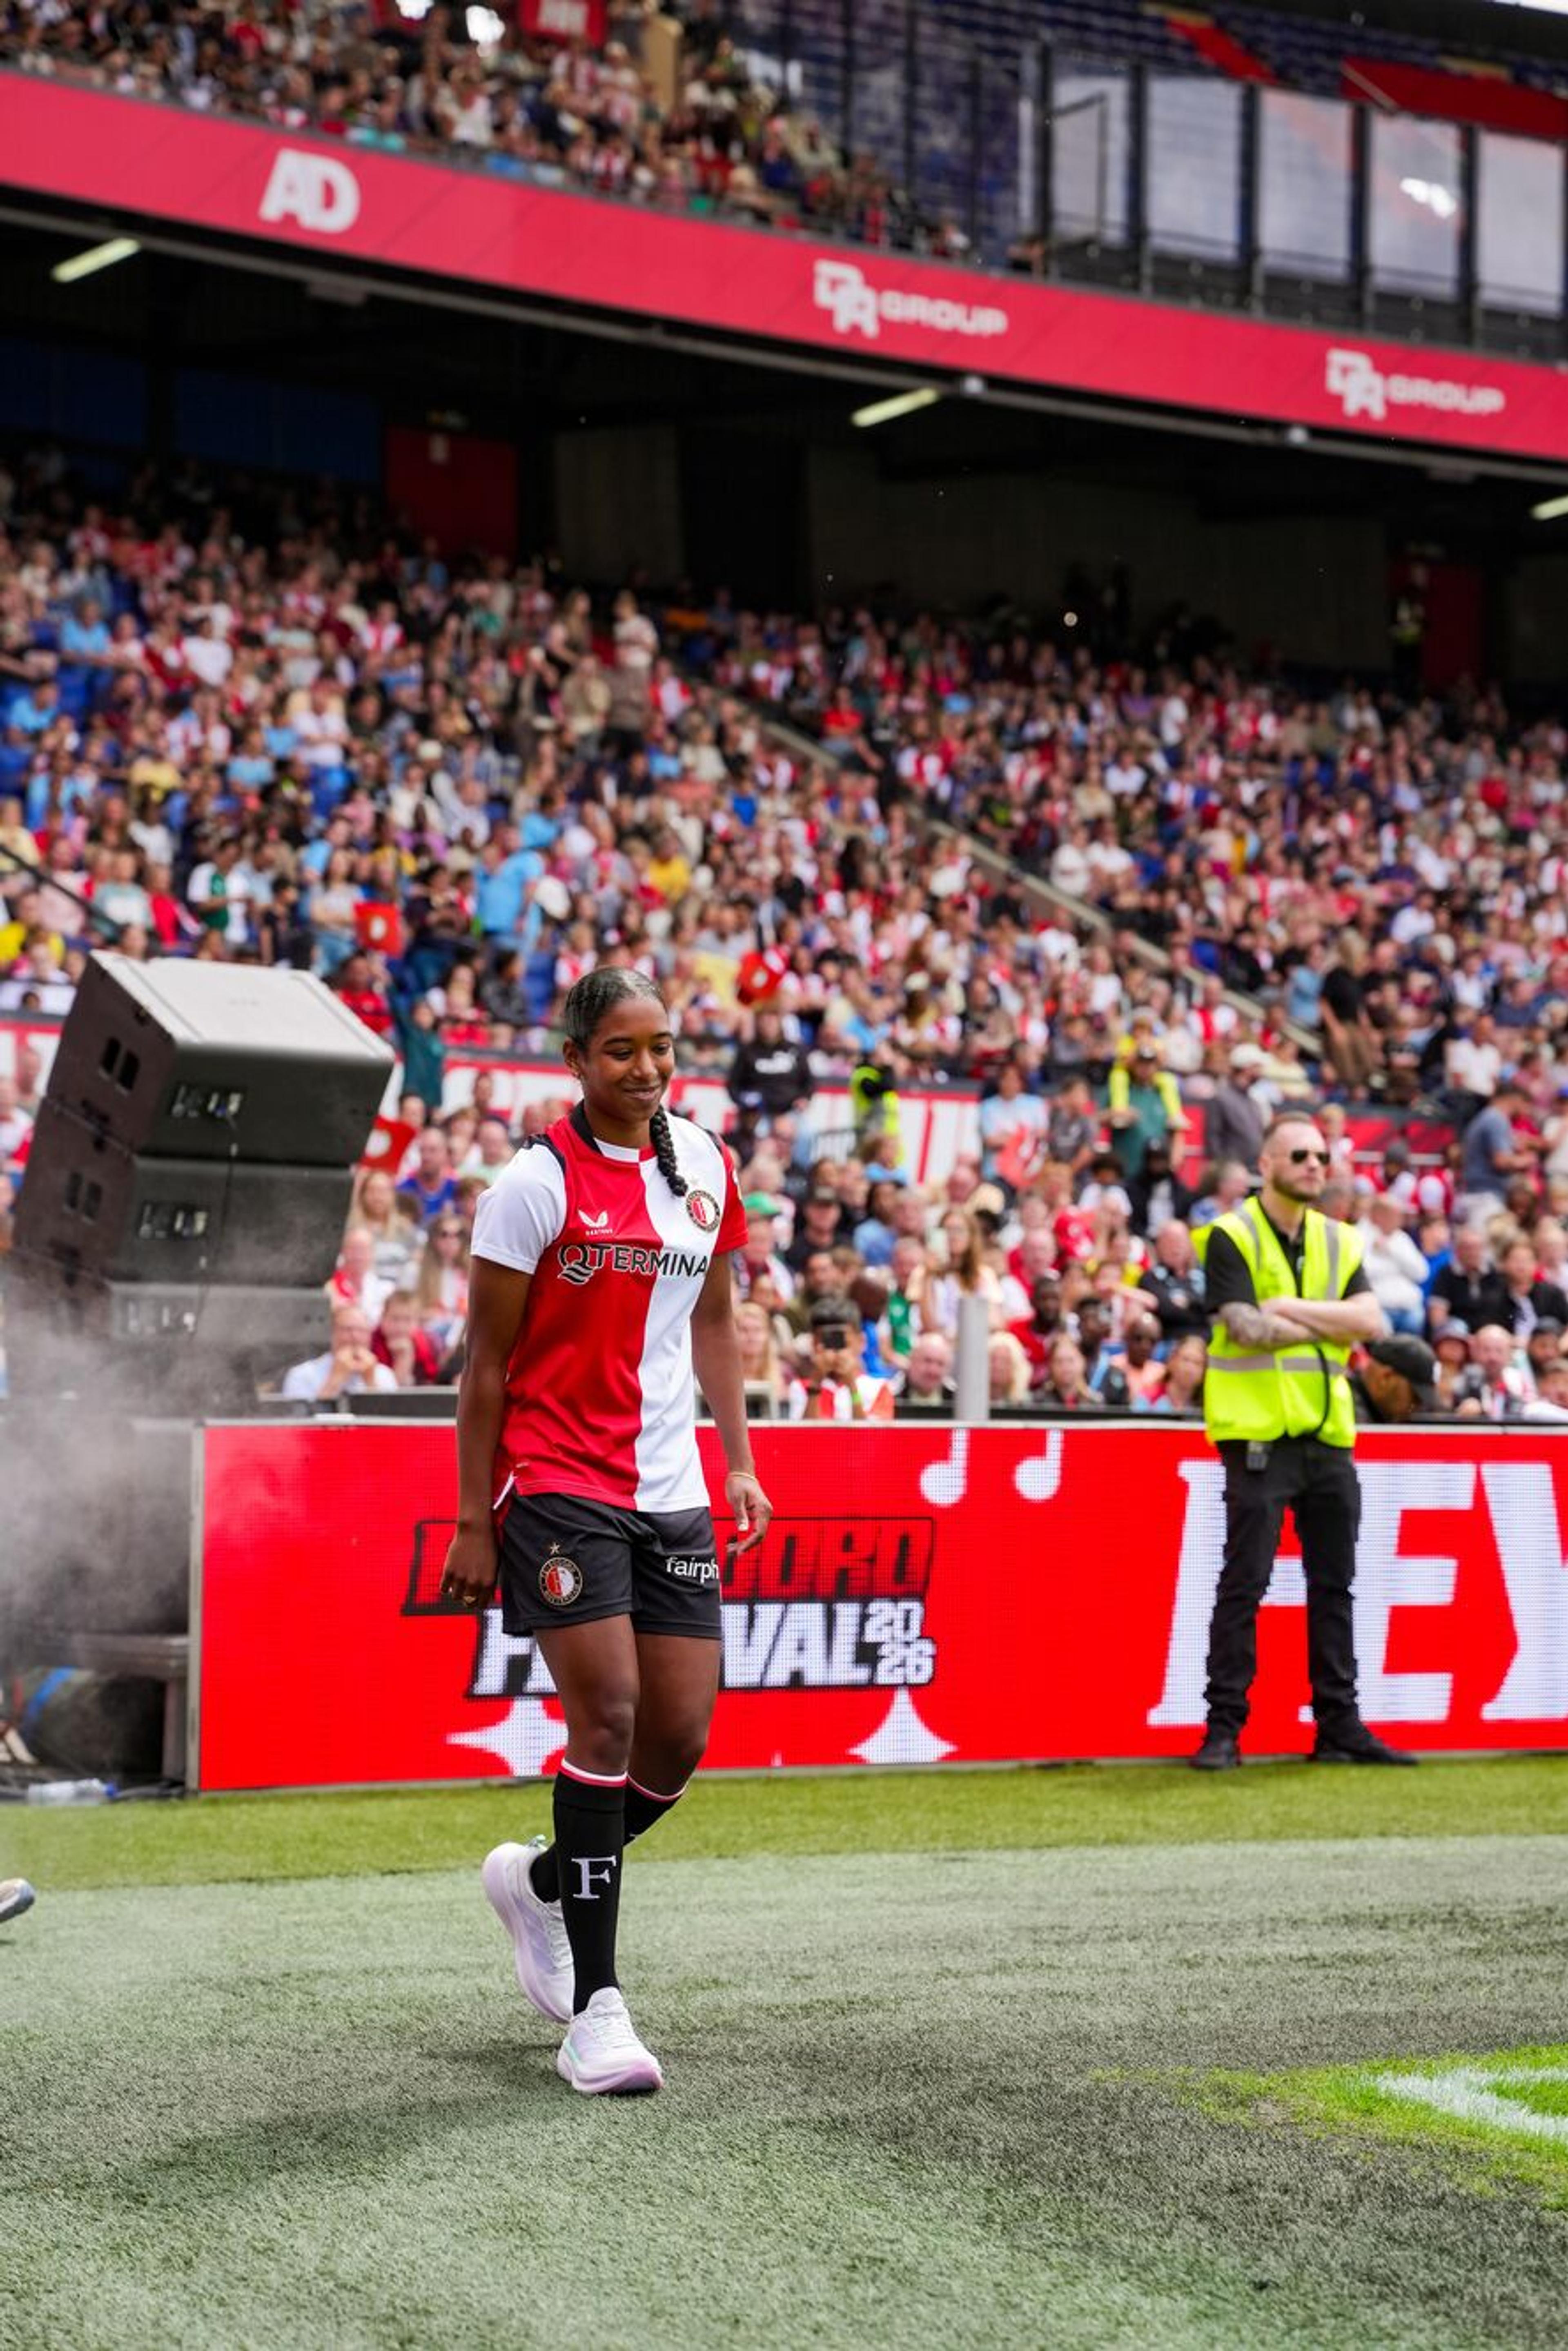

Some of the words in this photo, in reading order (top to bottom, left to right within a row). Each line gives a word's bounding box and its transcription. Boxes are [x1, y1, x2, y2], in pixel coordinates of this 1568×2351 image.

[259, 147, 361, 233] AD
[863, 1600, 924, 1642] 20
[874, 1639, 937, 1685] 26
[571, 1855, 616, 1899] F
